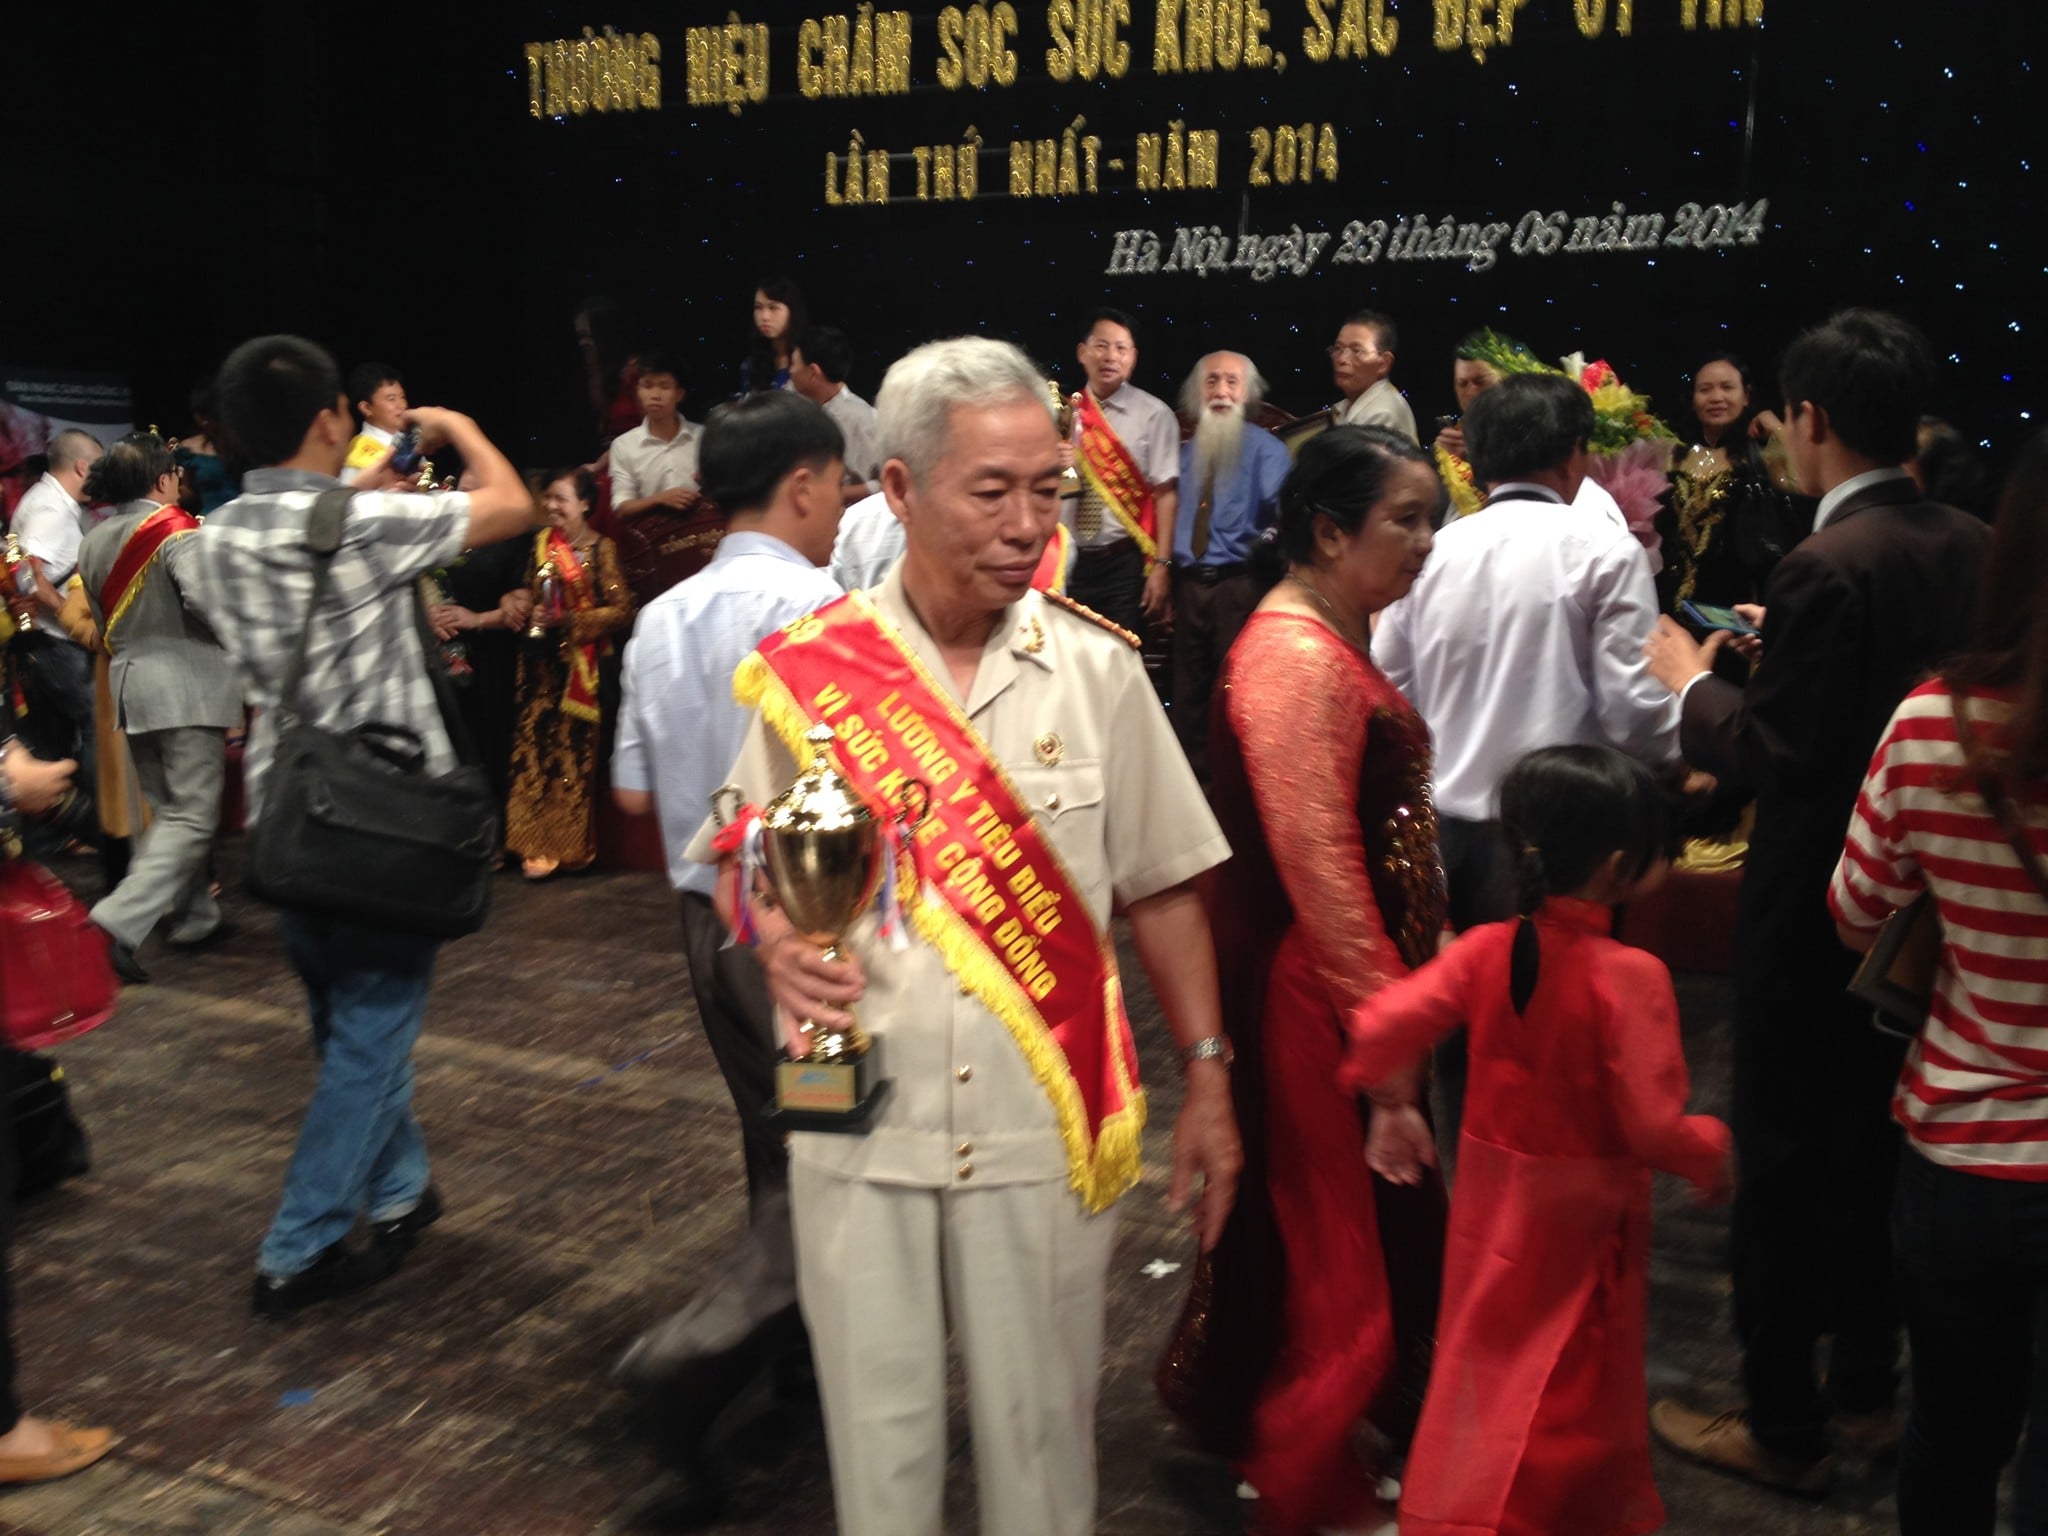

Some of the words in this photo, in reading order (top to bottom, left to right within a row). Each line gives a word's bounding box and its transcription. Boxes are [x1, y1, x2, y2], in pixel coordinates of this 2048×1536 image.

[686, 10, 770, 117] HIỆU
[798, 2, 911, 99] CHĂM
[825, 128, 889, 206] LẦN
[912, 124, 983, 201] THỨ
[1136, 119, 1219, 191] NĂM
[1249, 122, 1338, 188] 2014
[1104, 228, 1160, 276] Hà
[1231, 223, 1332, 282] ngày
[1331, 219, 1390, 264] 23
[1386, 213, 1511, 273] tháng
[1511, 210, 1569, 256] 06
[1562, 200, 1665, 254] năm
[1662, 198, 1769, 249] 2014
[813, 681, 854, 719] VÌ
[833, 713, 891, 774] SỨC
[875, 689, 960, 786] LƯƠNG
[948, 778, 980, 806] Y
[964, 800, 1024, 872] TIÊU
[1006, 863, 1063, 937] BIỂU
[934, 840, 1007, 927] CỘNG
[991, 916, 1058, 1002] ĐỒNG
